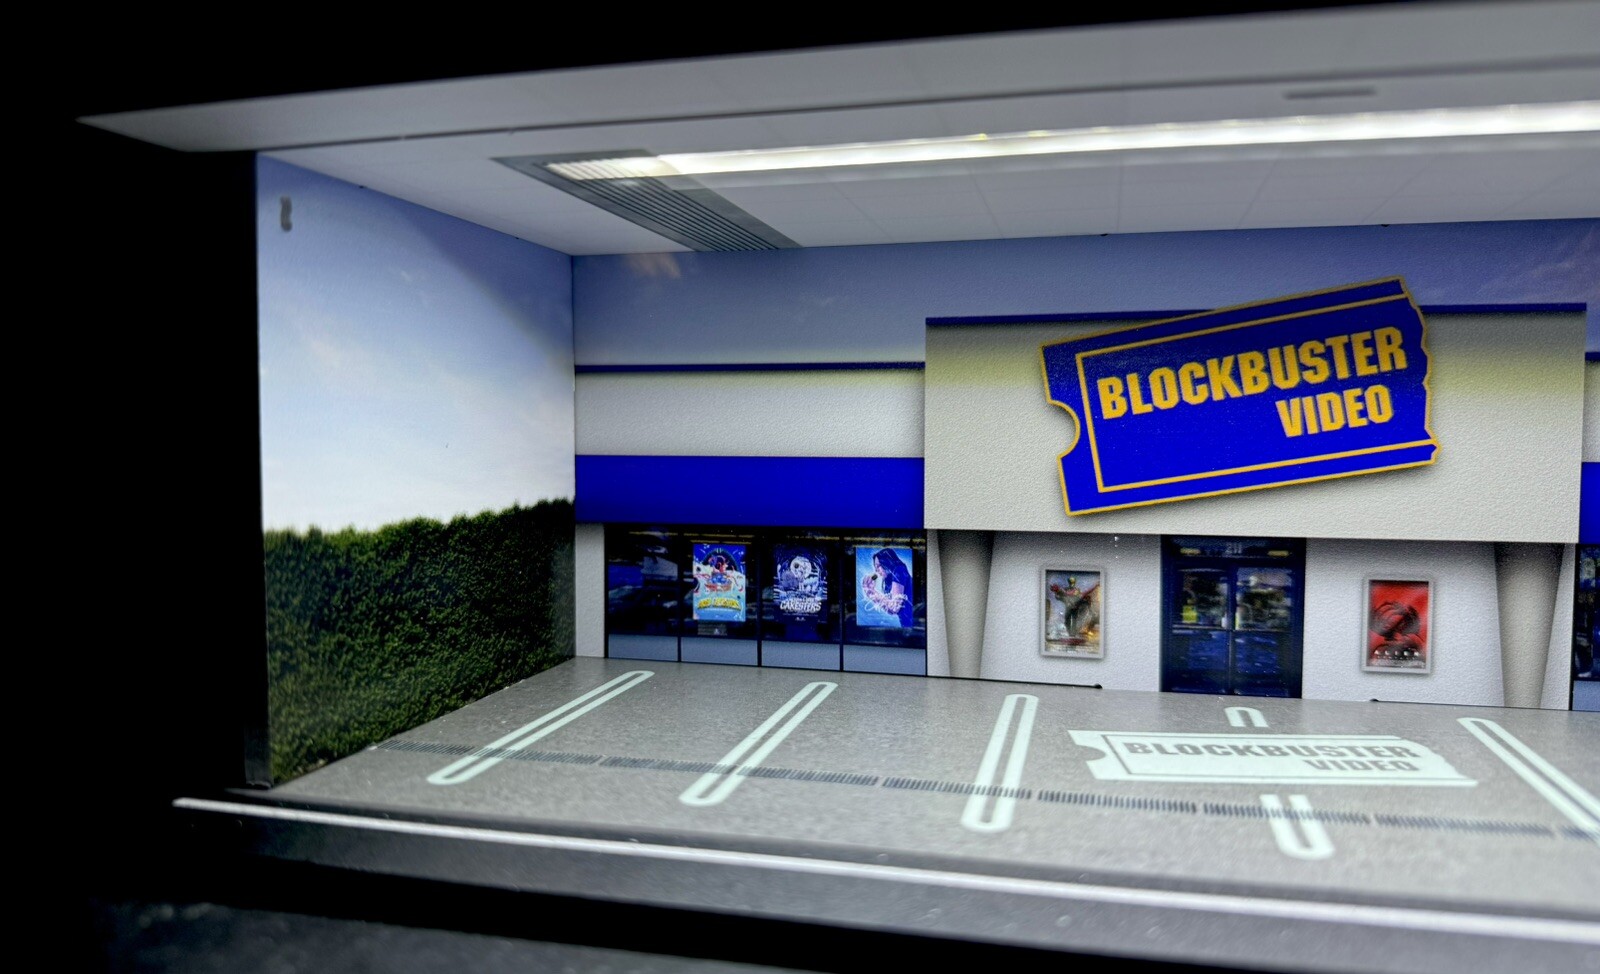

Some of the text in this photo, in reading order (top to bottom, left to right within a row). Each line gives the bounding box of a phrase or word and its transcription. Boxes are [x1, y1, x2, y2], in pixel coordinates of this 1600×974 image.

[1096, 327, 1407, 419] BLOCKBUSTER
[1276, 385, 1393, 437] VIDEO
[1123, 742, 1419, 758] BLOCKBUSTER
[1304, 759, 1419, 772] VIDEO
